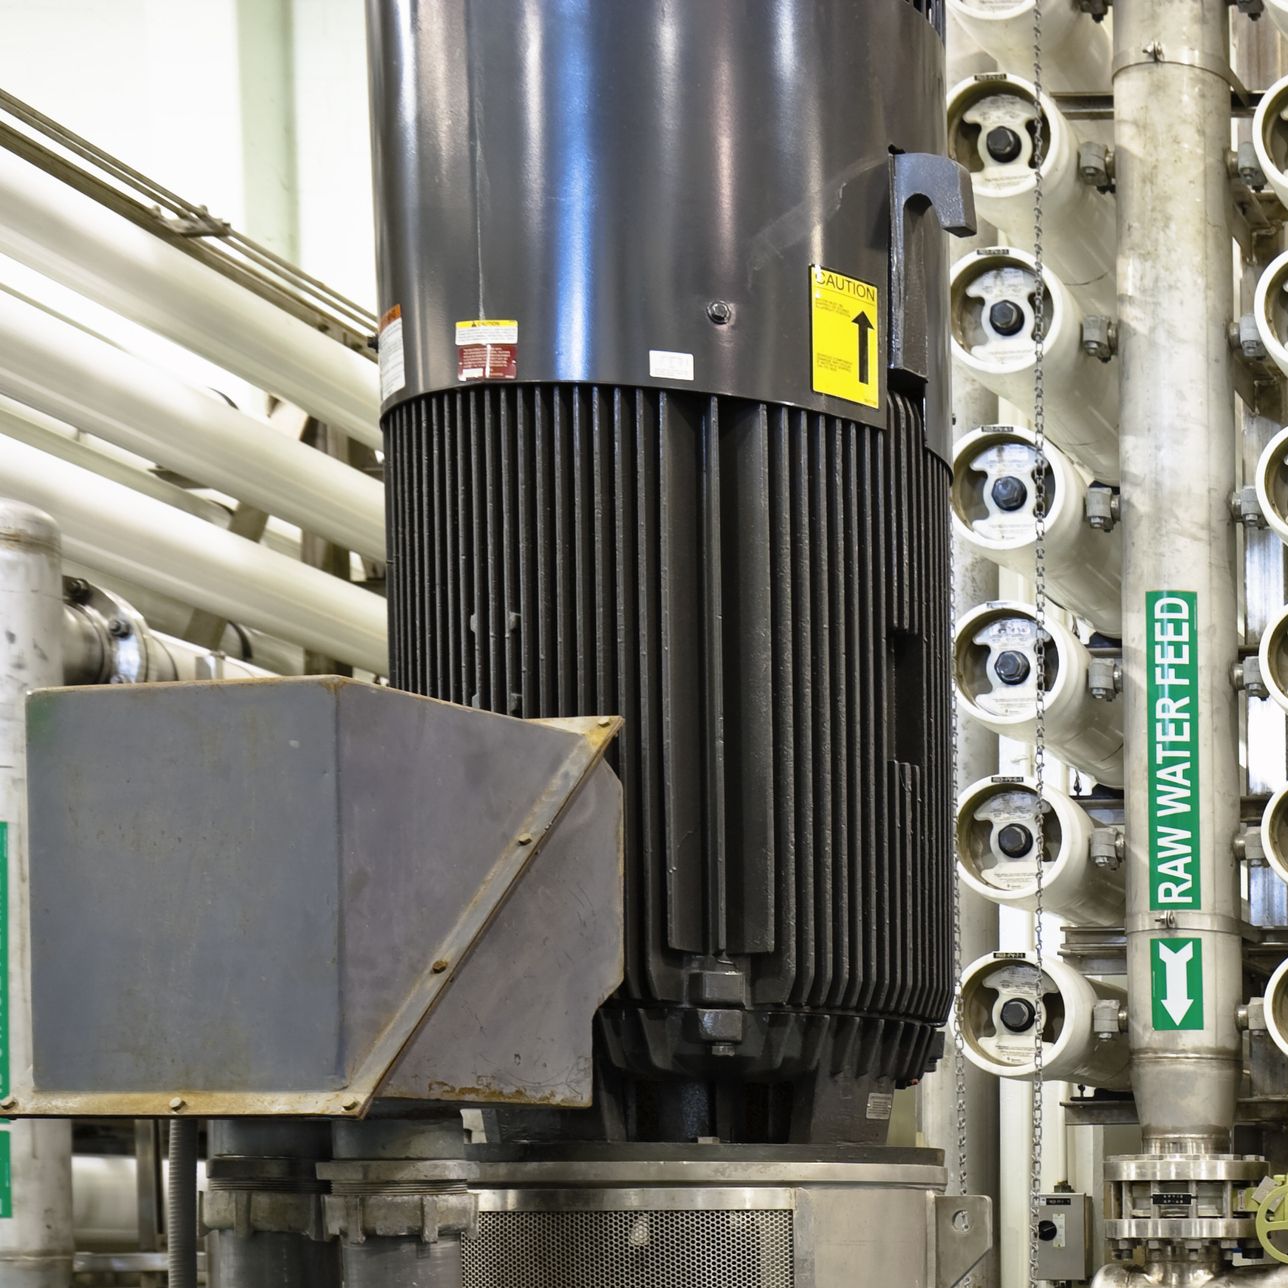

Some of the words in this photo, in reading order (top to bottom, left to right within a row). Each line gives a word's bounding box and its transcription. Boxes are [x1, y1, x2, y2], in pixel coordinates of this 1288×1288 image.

[815, 272, 876, 302] CAUTION
[1153, 597, 1190, 686] FEED
[1155, 695, 1192, 818] WATER
[1156, 825, 1193, 904] RAW
